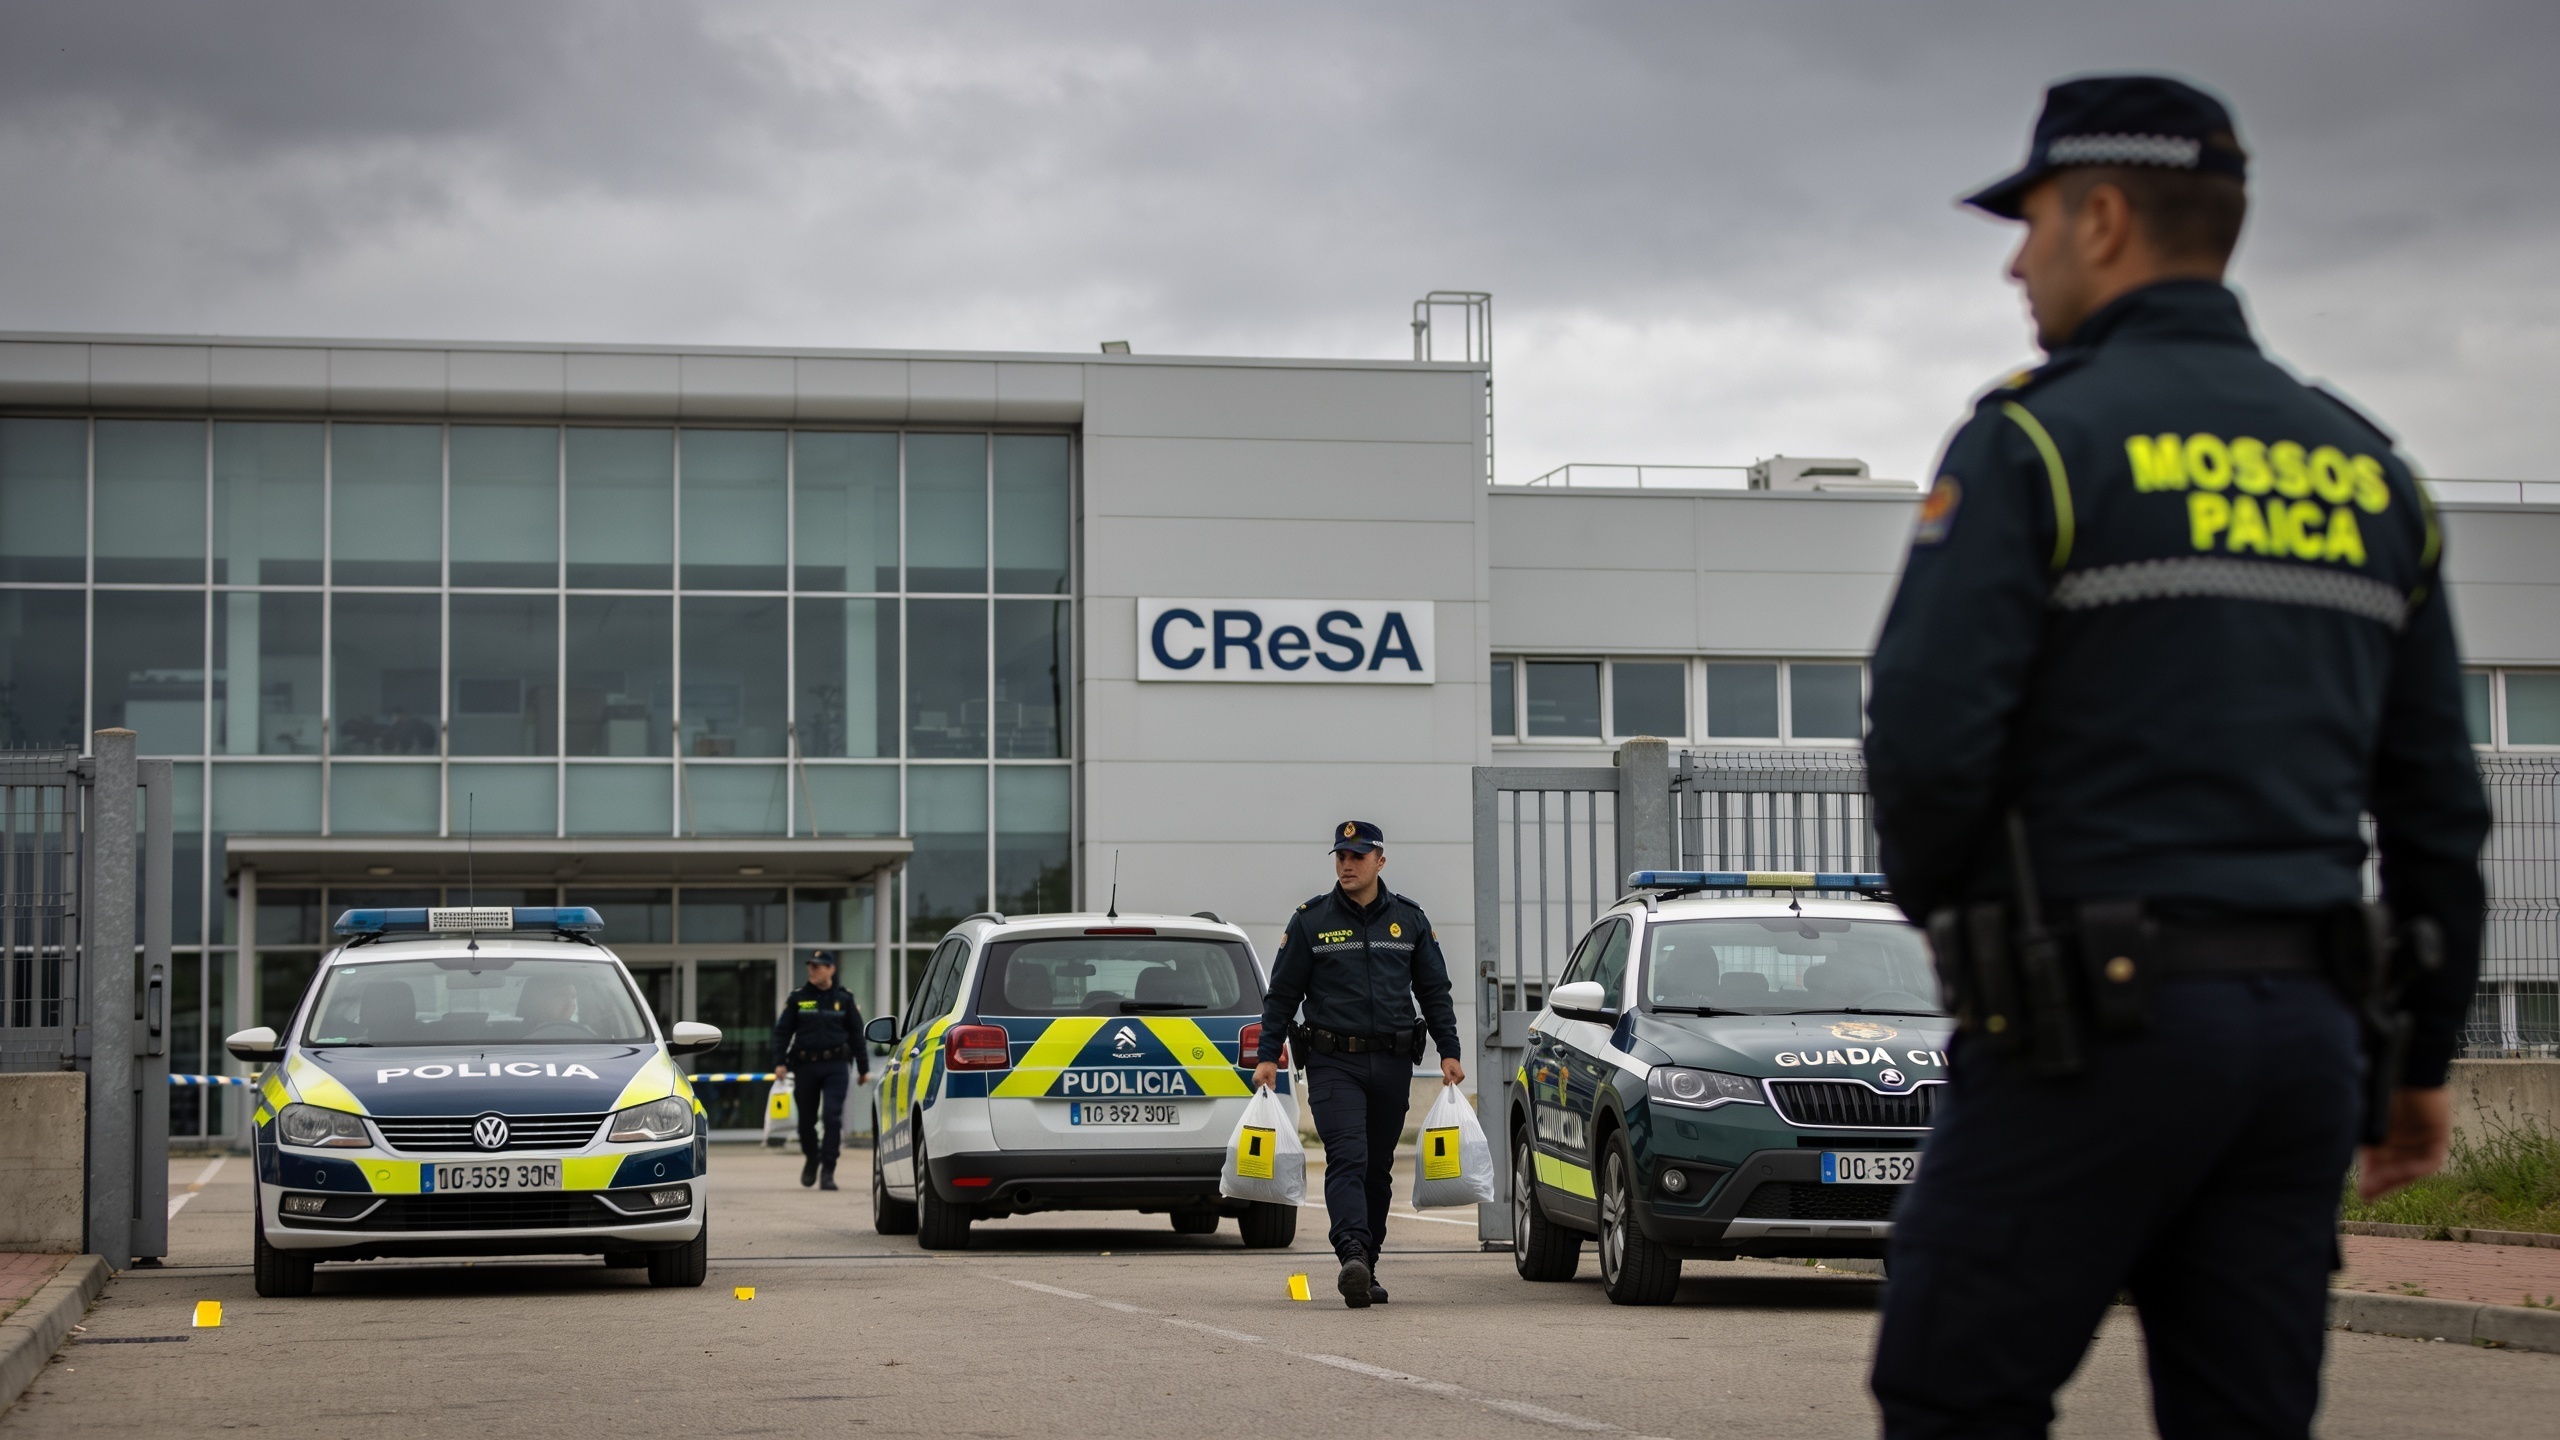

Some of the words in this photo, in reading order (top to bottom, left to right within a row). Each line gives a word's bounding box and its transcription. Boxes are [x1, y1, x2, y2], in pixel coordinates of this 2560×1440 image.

[2125, 433, 2390, 514] MOSSOS
[2187, 491, 2367, 566] PAICA
[1152, 608, 1424, 672] CReSA
[377, 1062, 600, 1084] POLICIA
[1063, 1071, 1187, 1095] PUDLICIA
